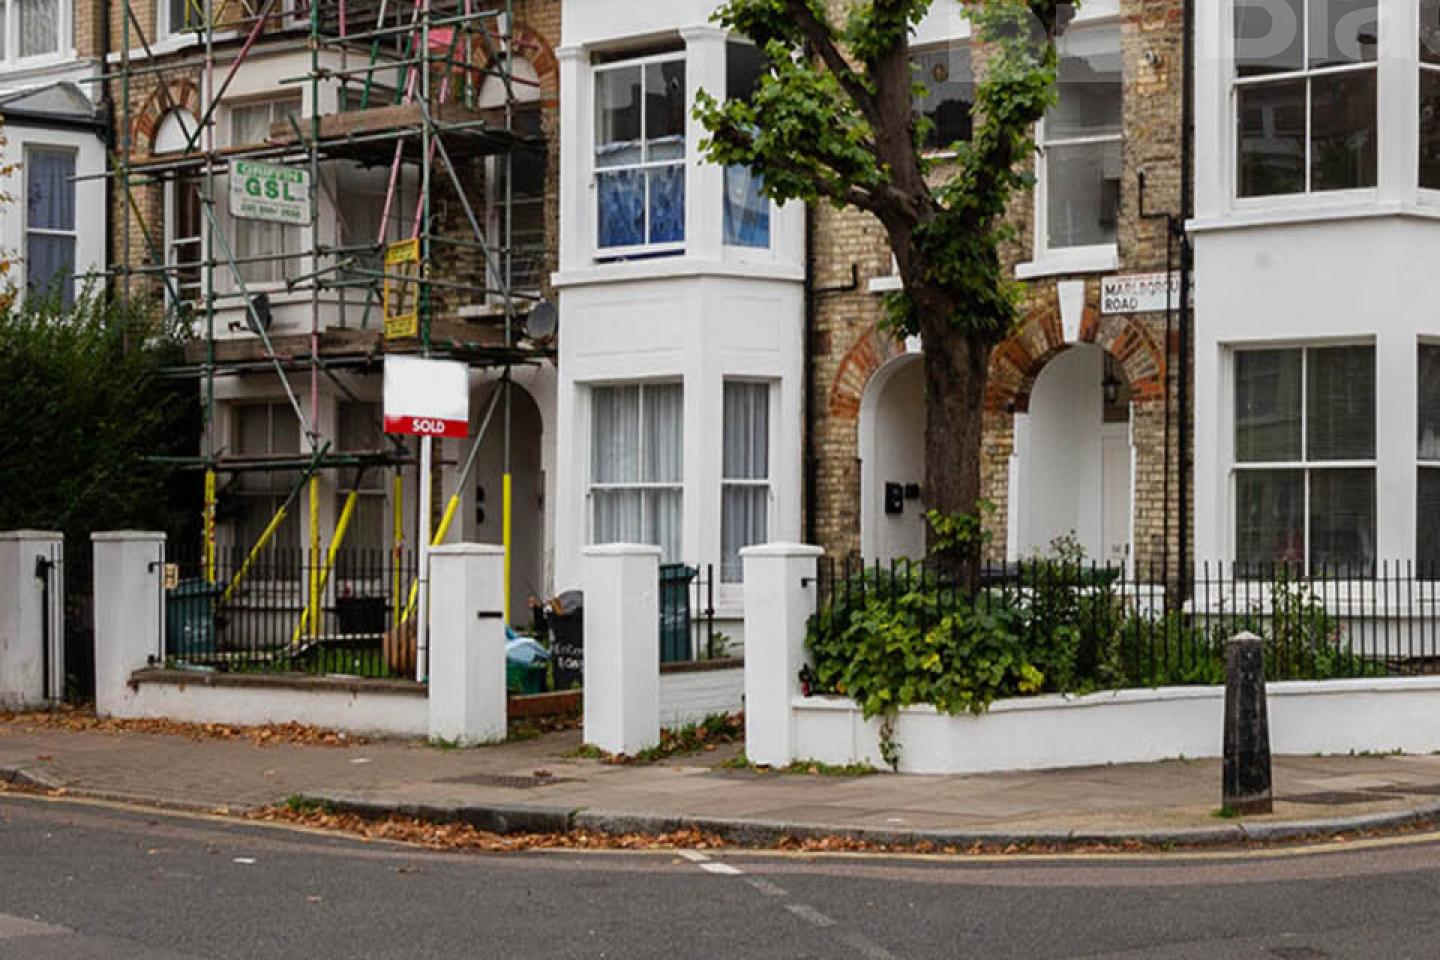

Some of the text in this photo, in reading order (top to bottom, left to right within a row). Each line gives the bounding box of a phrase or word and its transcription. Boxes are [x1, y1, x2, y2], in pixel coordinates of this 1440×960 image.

[245, 176, 296, 202] GSL
[1105, 297, 1138, 311] ROAD
[412, 418, 445, 434] SOLD
